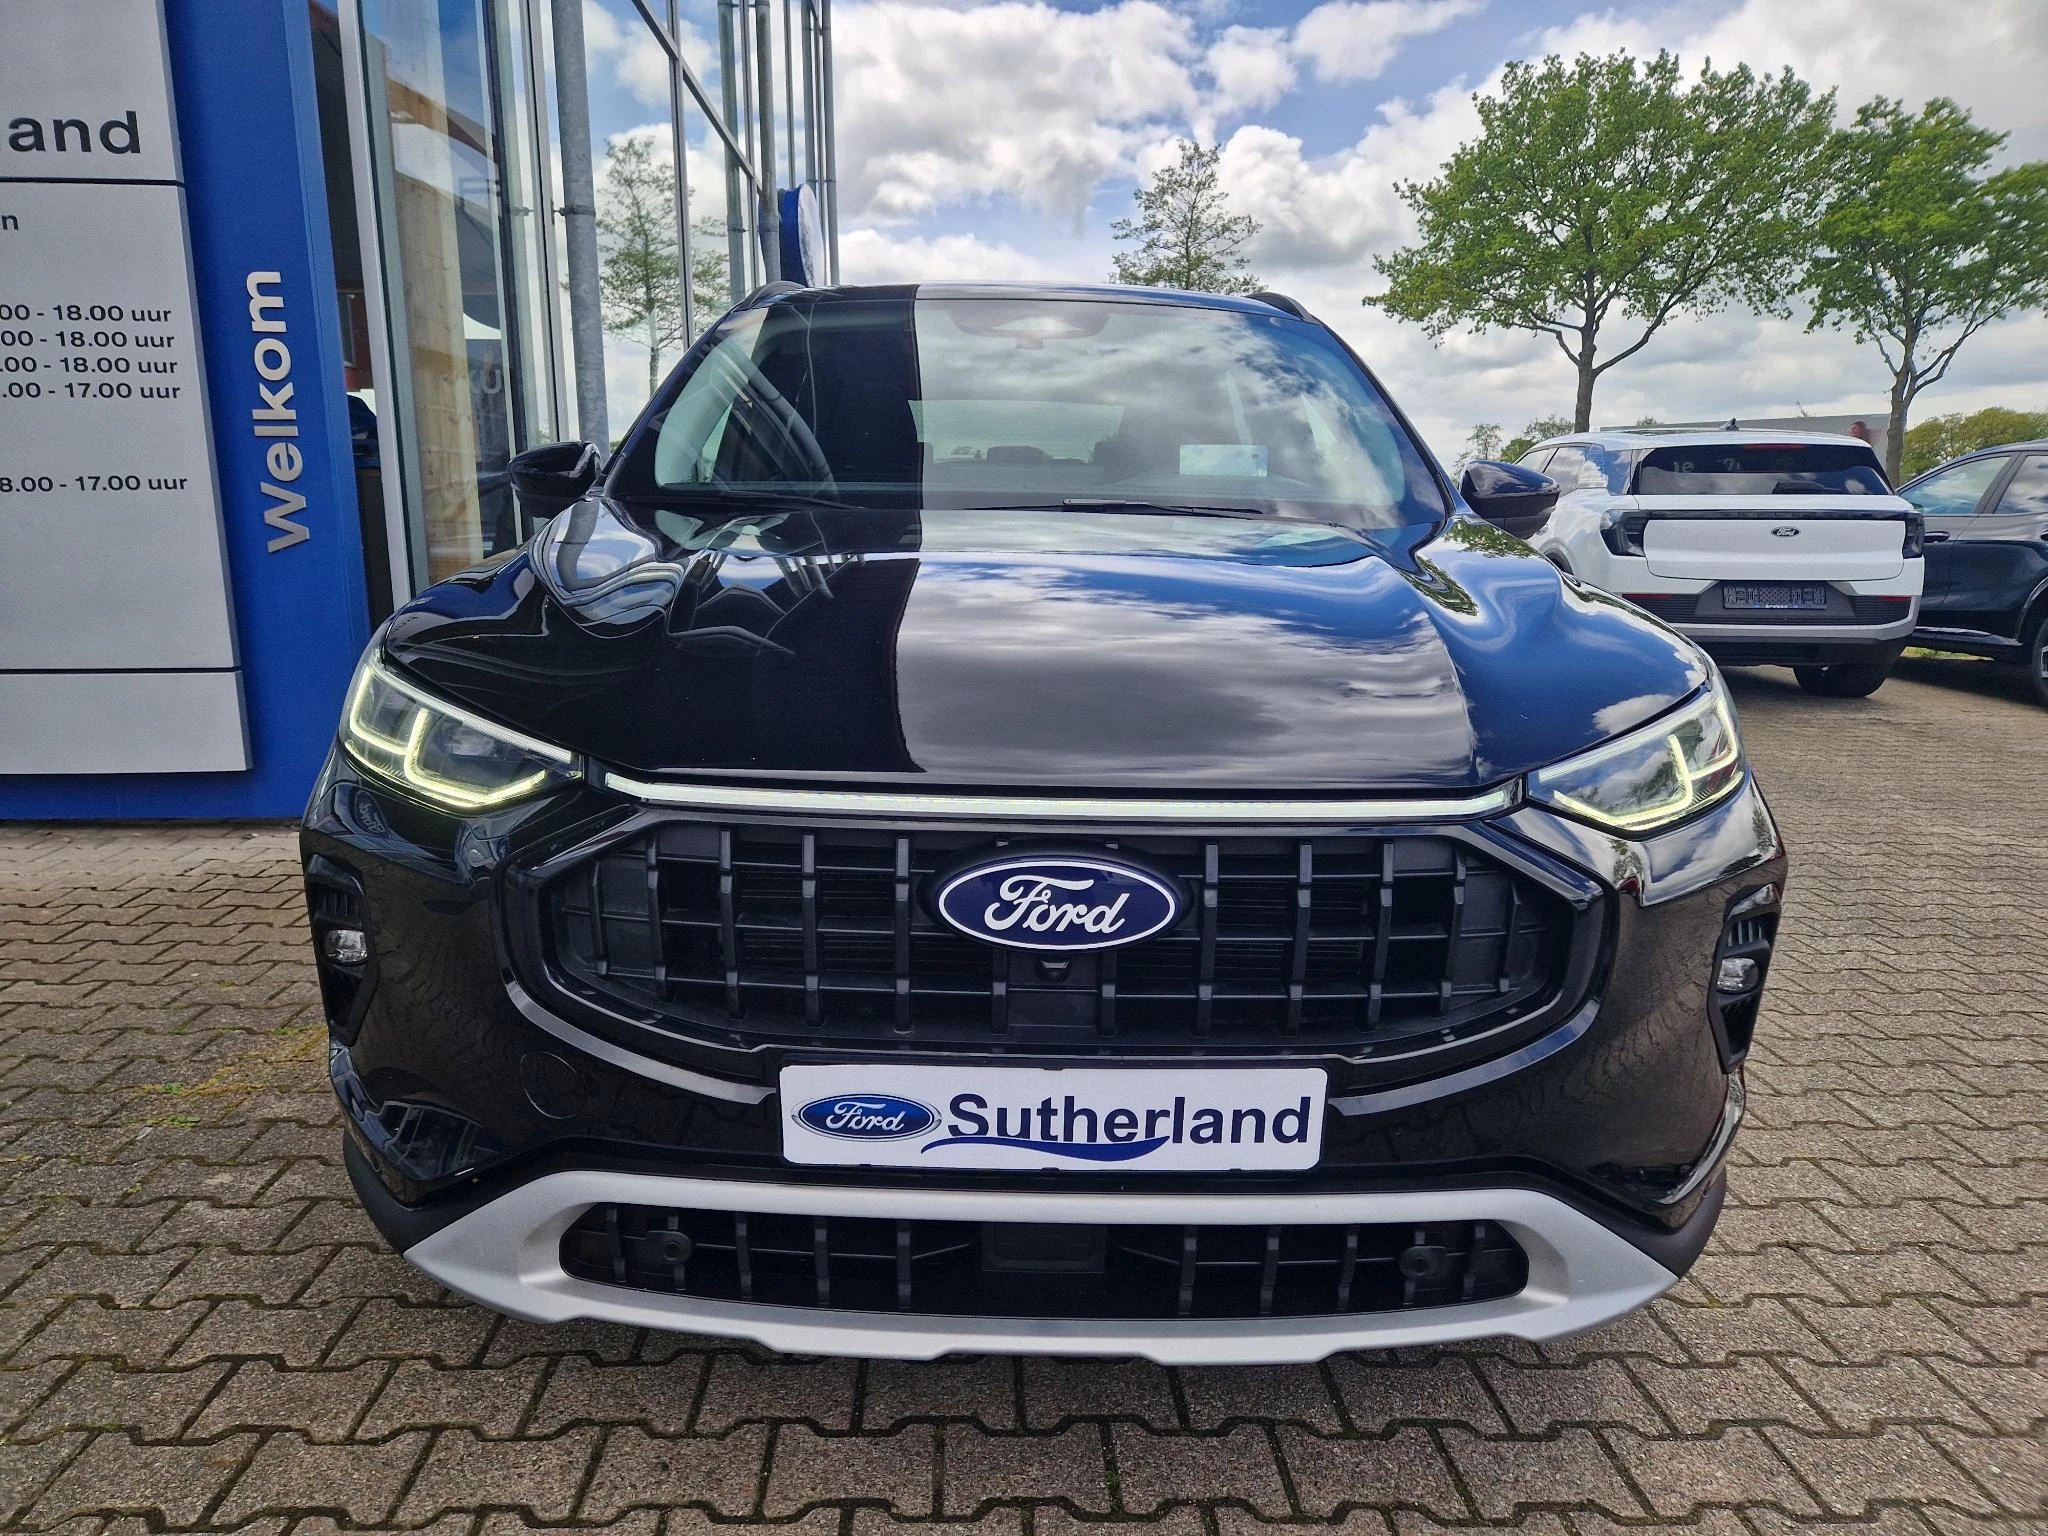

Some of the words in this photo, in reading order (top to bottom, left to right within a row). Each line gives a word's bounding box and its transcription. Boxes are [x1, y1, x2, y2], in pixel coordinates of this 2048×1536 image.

[52, 304, 124, 322] 18.00
[131, 309, 172, 323] uur
[54, 330, 128, 348] 18.00
[134, 335, 175, 348] uur
[59, 356, 131, 374] 18.00
[137, 361, 178, 374] uur
[64, 382, 133, 399] 17.00
[139, 386, 181, 399] uur
[247, 271, 310, 553] Welkom
[74, 474, 141, 492] 17.00
[147, 477, 188, 491] uur
[984, 874, 1131, 934] Ford
[825, 1101, 906, 1132] Ford
[947, 1093, 1312, 1144] Sutherland
